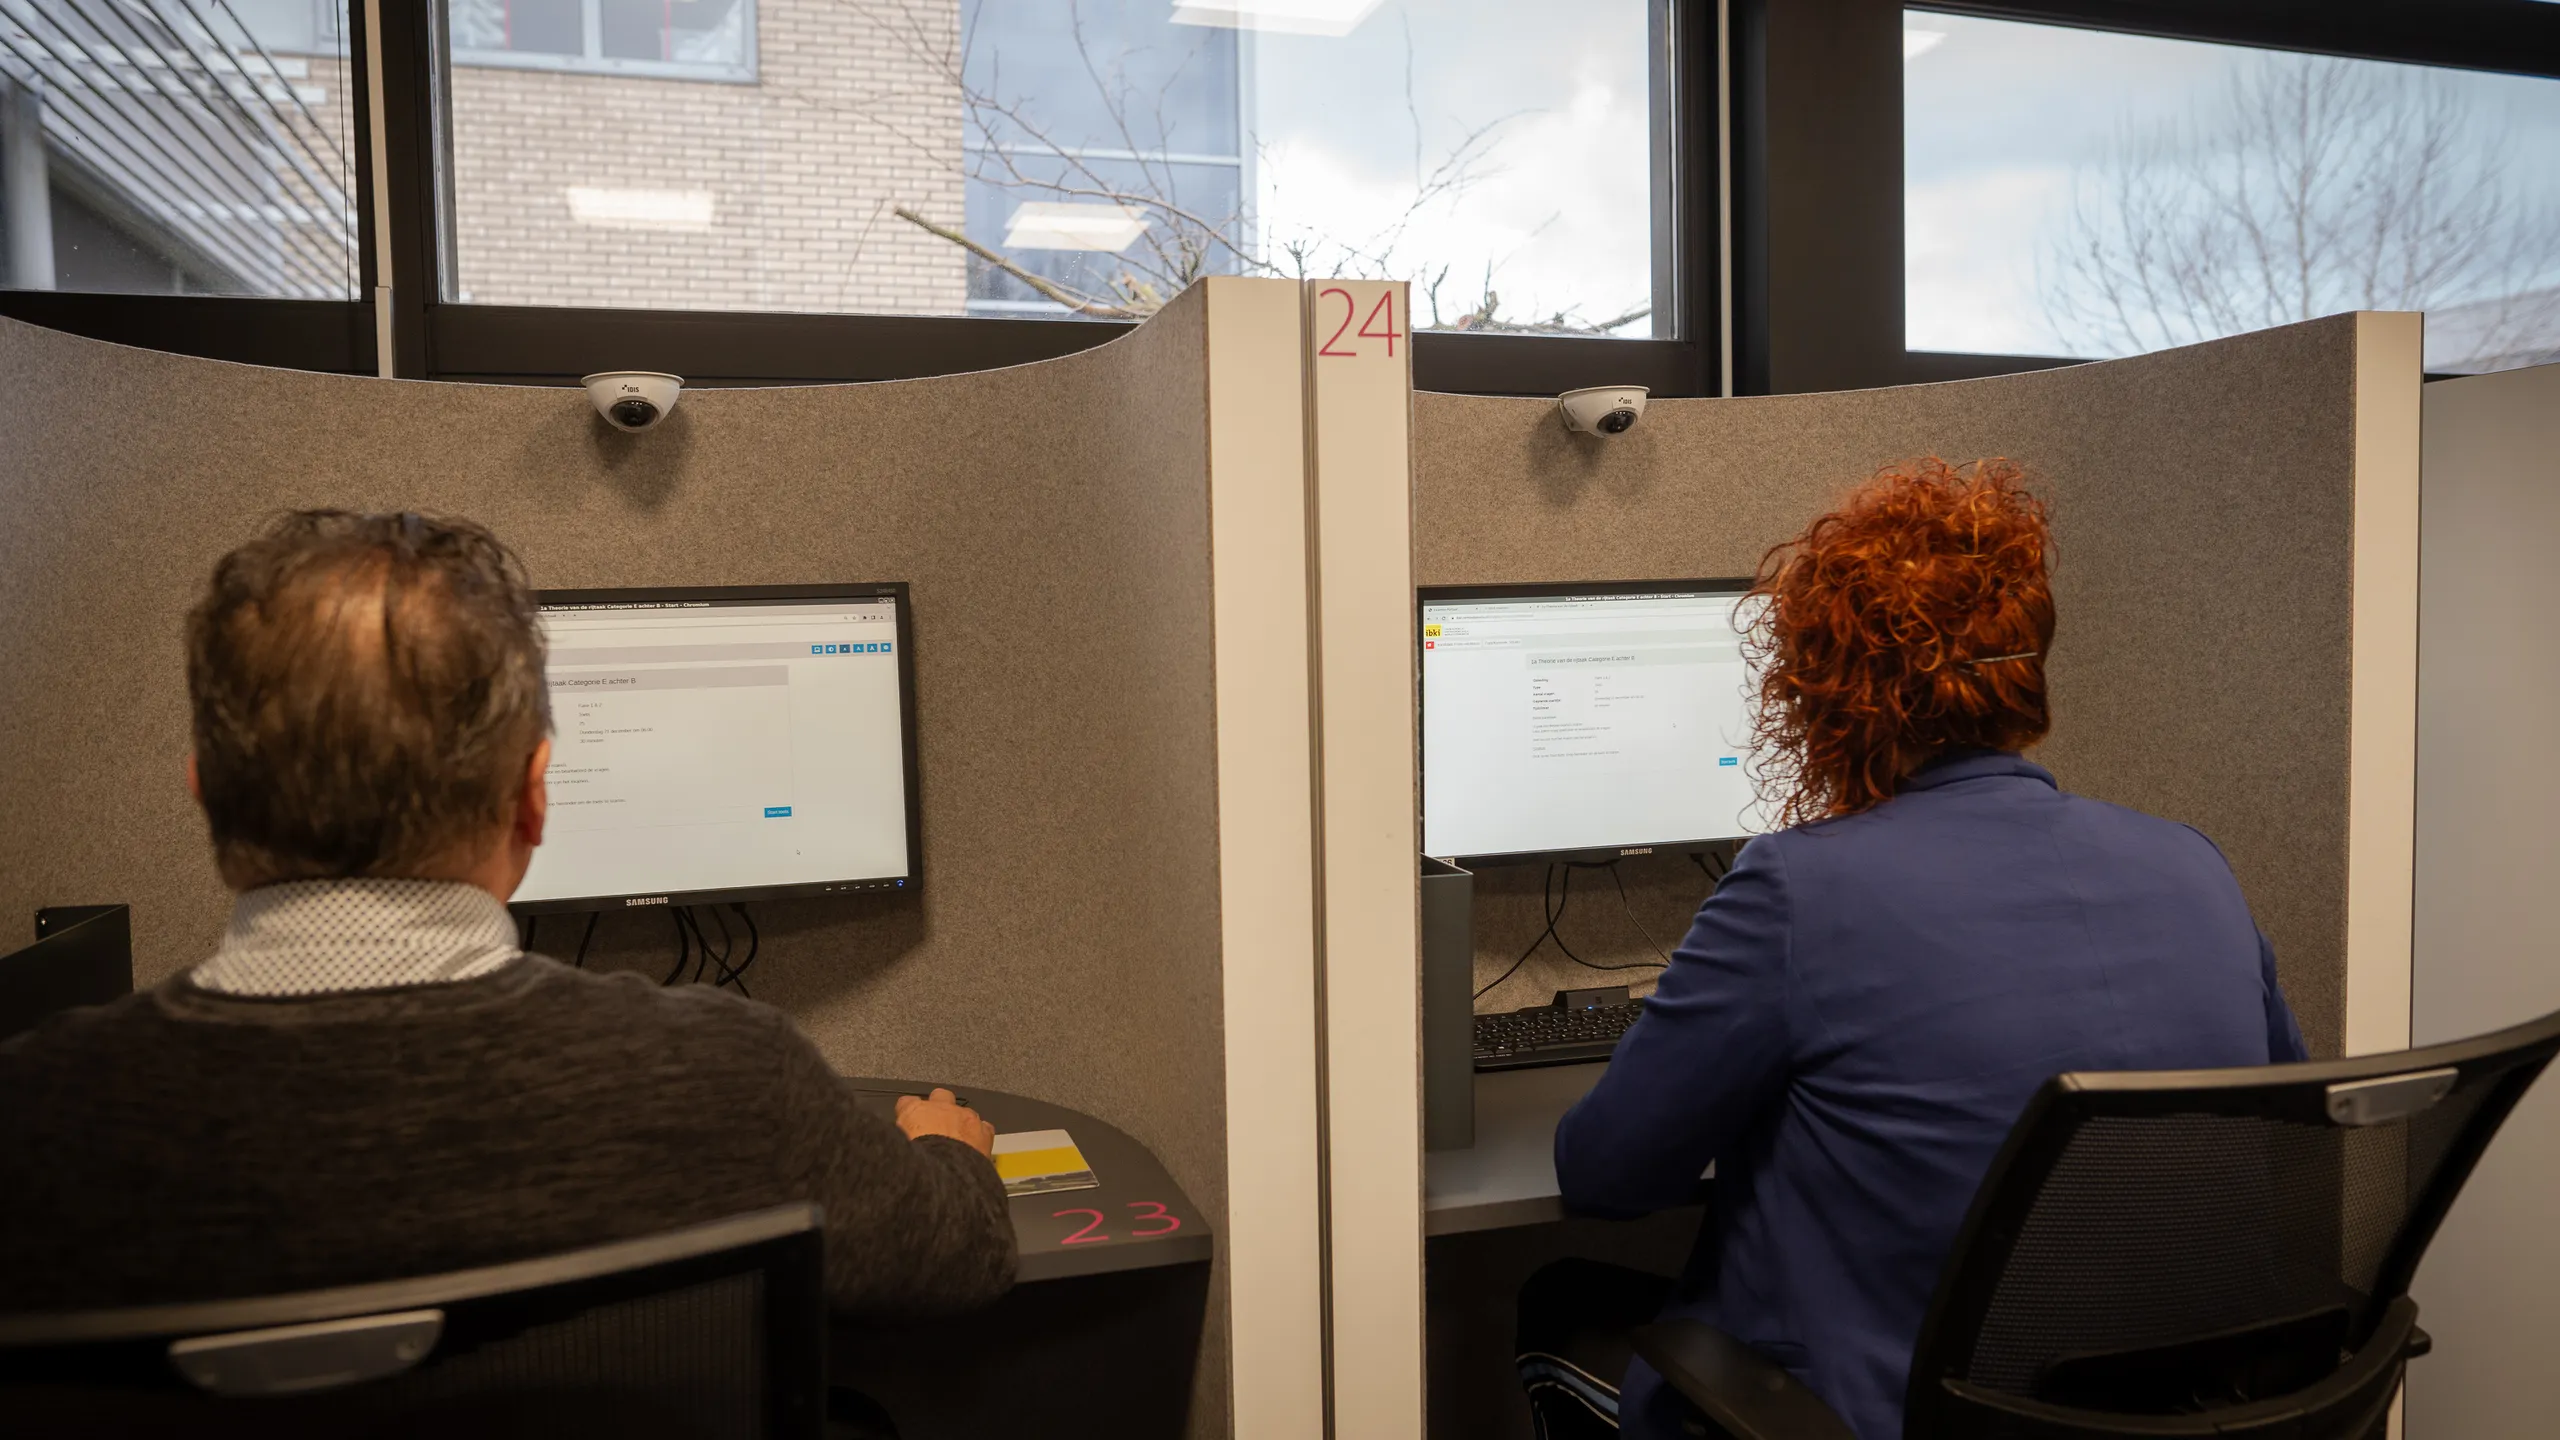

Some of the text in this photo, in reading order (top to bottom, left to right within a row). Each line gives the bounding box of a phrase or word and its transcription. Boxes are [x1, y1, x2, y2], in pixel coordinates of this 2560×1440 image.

[1318, 288, 1402, 357] 24
[1425, 629, 1441, 637] ibki
[568, 679, 601, 687] Categorie
[608, 677, 629, 685] achter
[1620, 848, 1653, 856] SAMSUNG
[626, 896, 669, 907] SAMSUNG
[1052, 1201, 1181, 1245] 23
